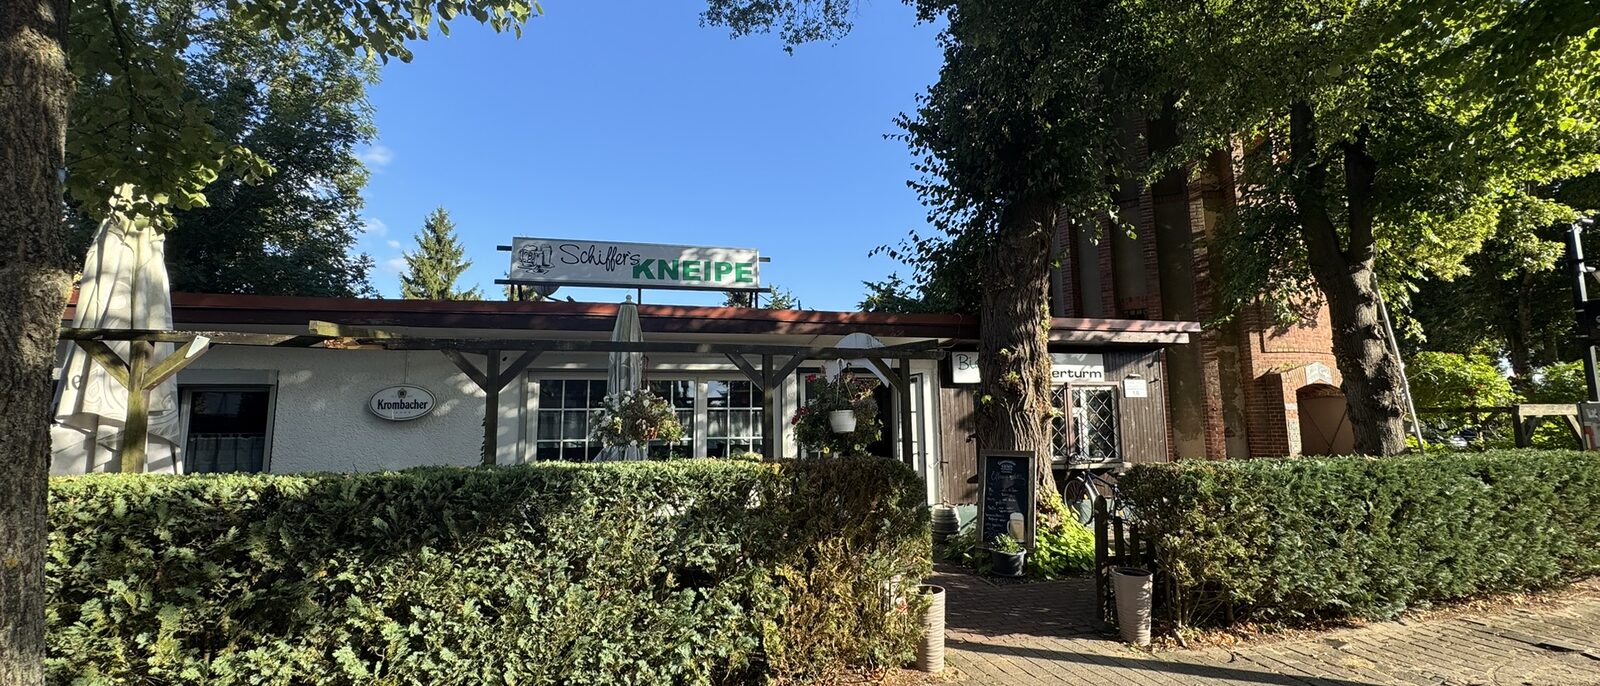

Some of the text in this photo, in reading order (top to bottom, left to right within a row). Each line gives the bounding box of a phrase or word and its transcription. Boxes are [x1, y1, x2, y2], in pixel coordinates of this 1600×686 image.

[632, 258, 754, 283] KNEIPE
[1051, 369, 1102, 378] erturm
[377, 398, 429, 410] Krombacher
